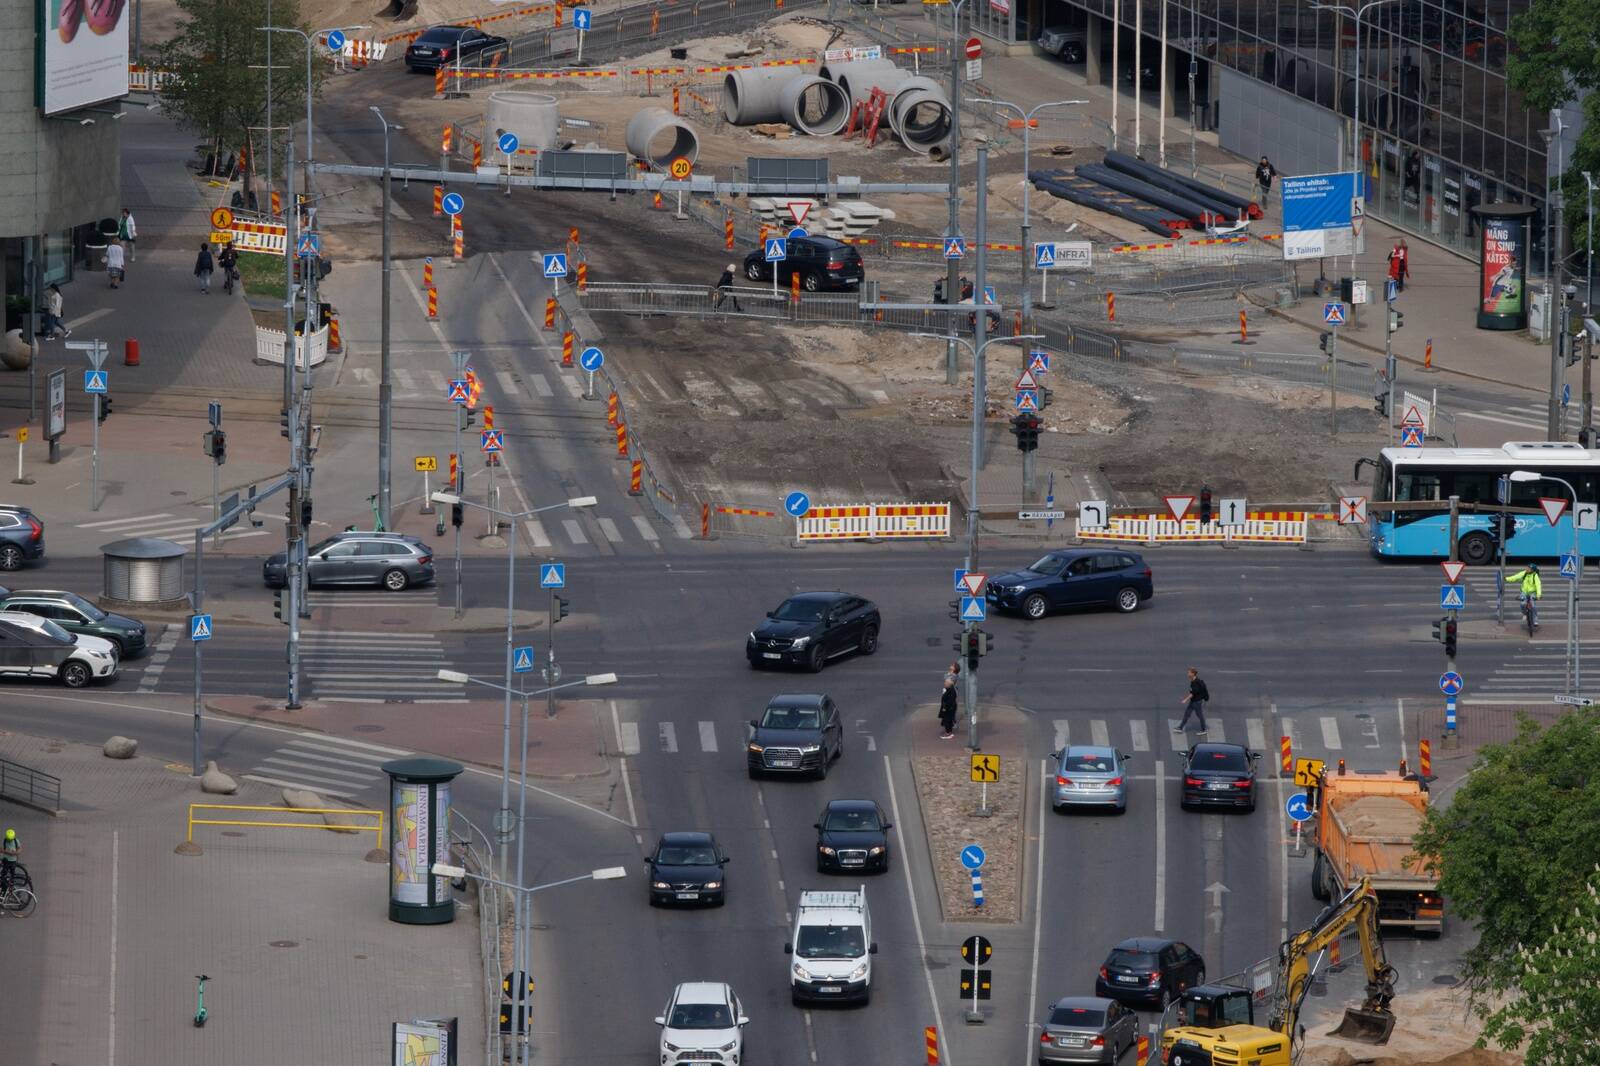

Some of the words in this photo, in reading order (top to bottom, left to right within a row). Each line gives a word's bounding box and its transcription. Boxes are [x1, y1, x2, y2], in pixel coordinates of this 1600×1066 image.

[676, 163, 687, 173] 20
[1487, 228, 1508, 240] MÄNG
[1296, 246, 1322, 254] Tallinn
[1486, 240, 1496, 250] ON
[1497, 241, 1516, 252] SINU
[1056, 250, 1086, 258] INFRA
[1486, 252, 1509, 264] KÄTES
[418, 784, 427, 864] LINNAMAARDLA
